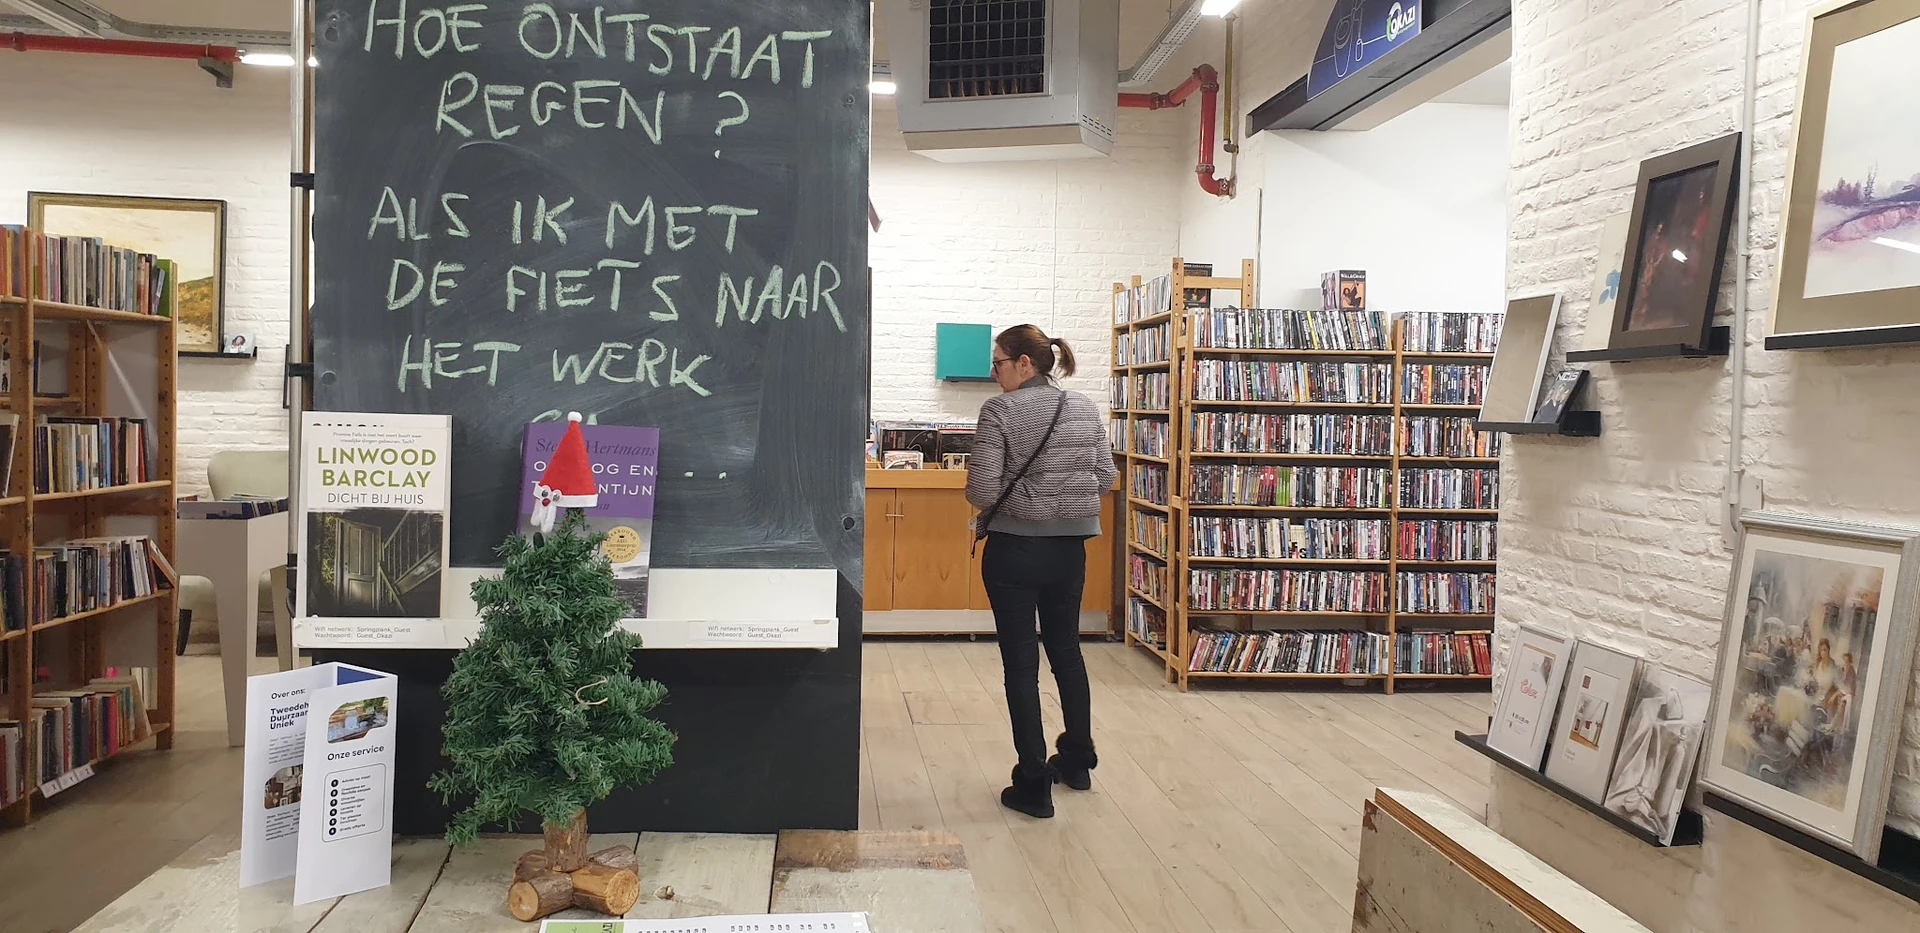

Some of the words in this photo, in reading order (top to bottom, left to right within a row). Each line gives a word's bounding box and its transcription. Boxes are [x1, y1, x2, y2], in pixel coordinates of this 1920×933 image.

[364, 2, 488, 59] HOE
[517, 3, 832, 87] ONTSTAAT
[436, 71, 665, 145] REGEN
[713, 90, 750, 159] ?
[367, 186, 471, 241] ALS
[512, 195, 575, 247] IK
[605, 194, 759, 255] MET
[386, 259, 465, 312] DE
[506, 259, 680, 323] FIETS
[715, 259, 848, 333] NAAR
[398, 334, 521, 394] HET
[552, 338, 712, 397] WERK
[1556, 371, 1580, 381] NCIS
[586, 440, 656, 456] Hertmans
[317, 447, 437, 466] LINWOOD
[533, 460, 620, 475] OOG
[629, 465, 654, 476] EN
[322, 469, 431, 488] BARCLAY
[531, 480, 653, 496] TNTIJN
[327, 493, 368, 503] DICHT
[371, 493, 390, 504] BIJ
[394, 494, 424, 504] HUIS
[271, 691, 290, 700] Over
[291, 688, 306, 696] ons:
[270, 720, 295, 730] Uniek
[327, 751, 351, 761] Onze
[352, 745, 385, 757] service
